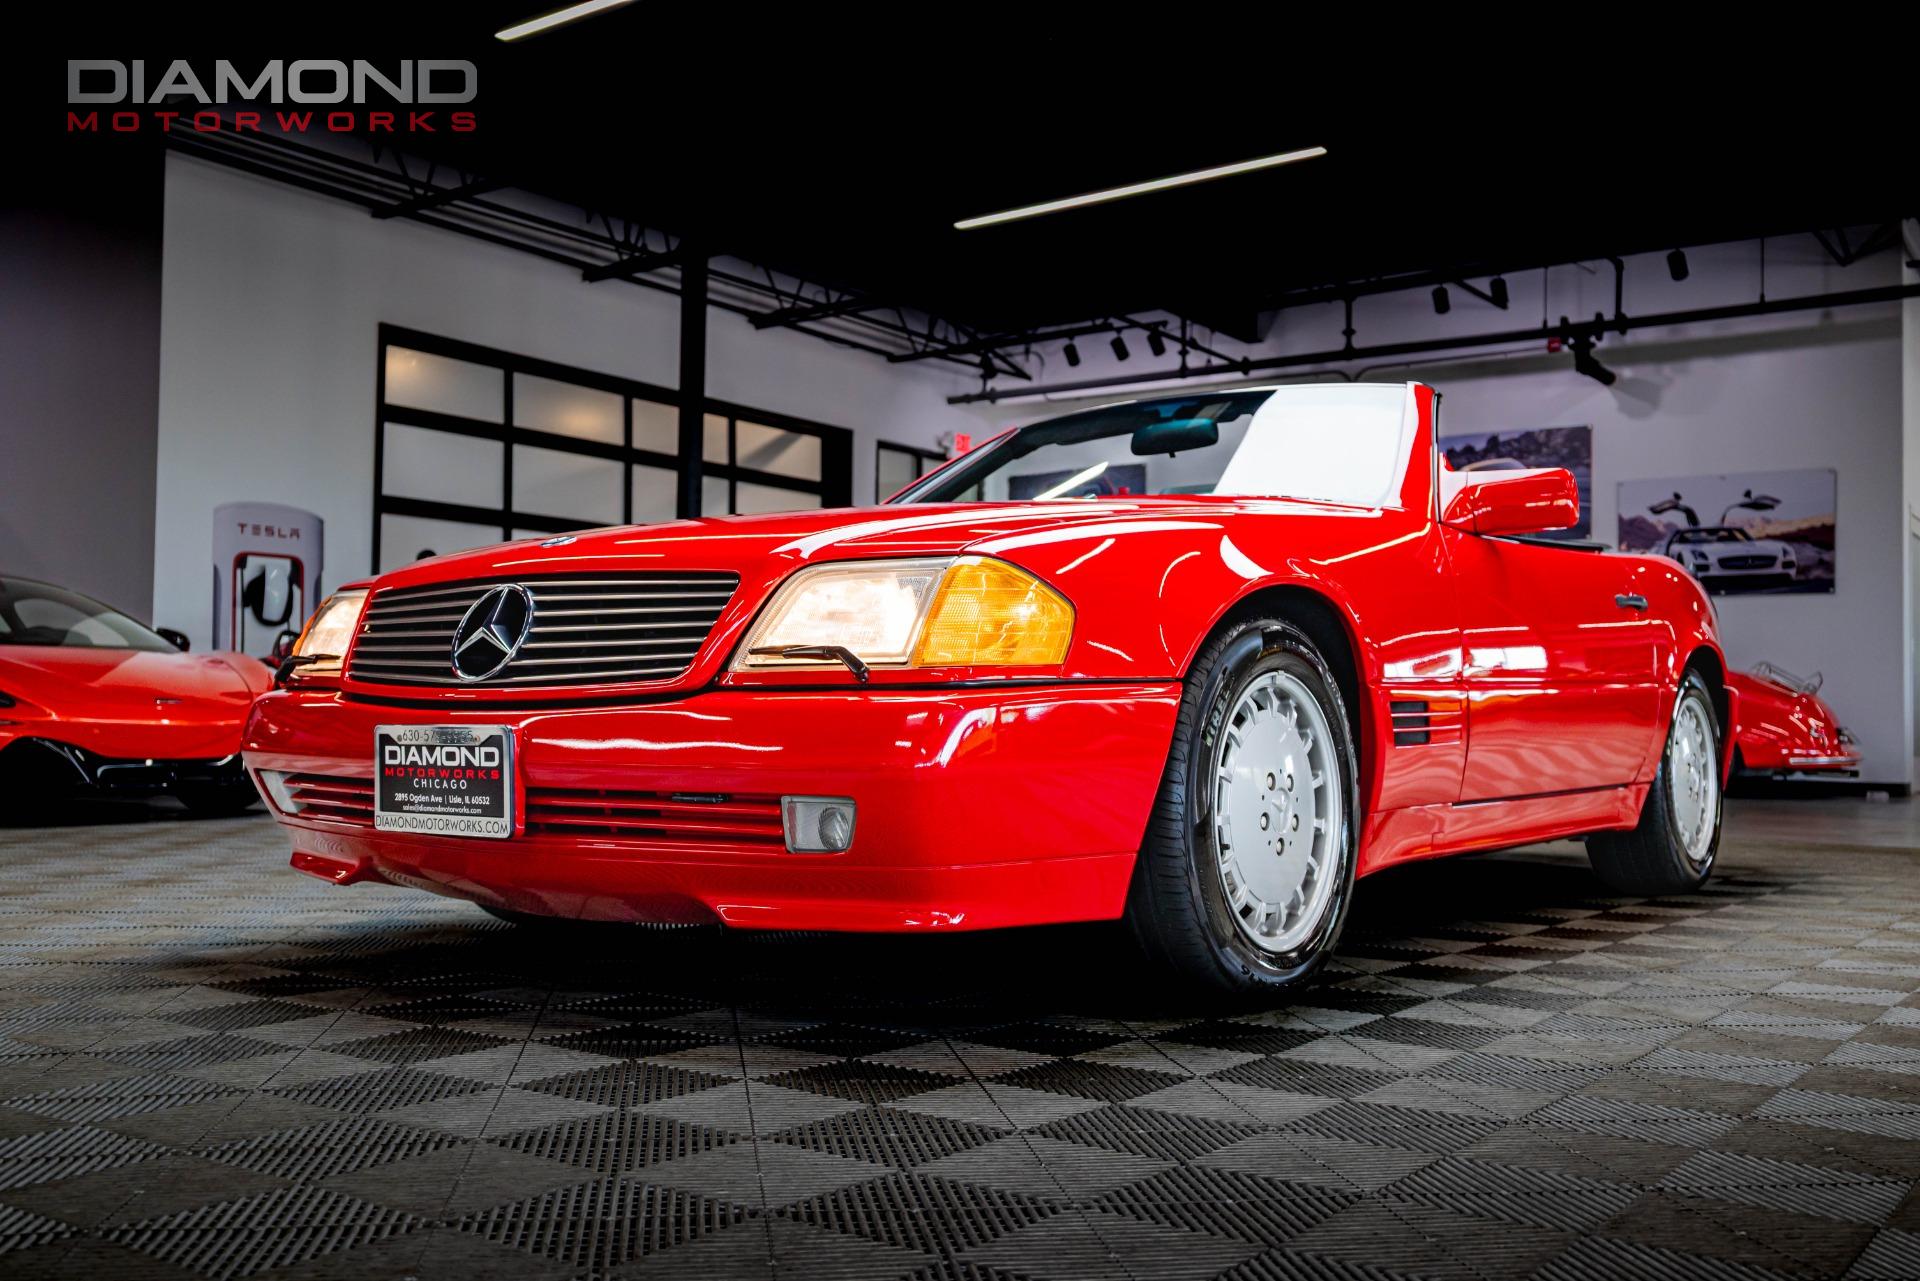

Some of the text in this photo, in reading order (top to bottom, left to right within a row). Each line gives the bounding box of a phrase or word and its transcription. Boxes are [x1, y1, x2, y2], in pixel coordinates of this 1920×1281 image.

[237, 523, 301, 539] TESLA
[384, 745, 500, 767] DIAMOND
[384, 768, 500, 779] MOTORWORKS
[413, 778, 468, 790] CHICAGO
[409, 793, 430, 804] Ogden
[430, 795, 443, 804] Ave
[471, 796, 491, 806] 60532
[375, 815, 508, 834] DIAMONDMOTORWORKS.COM
